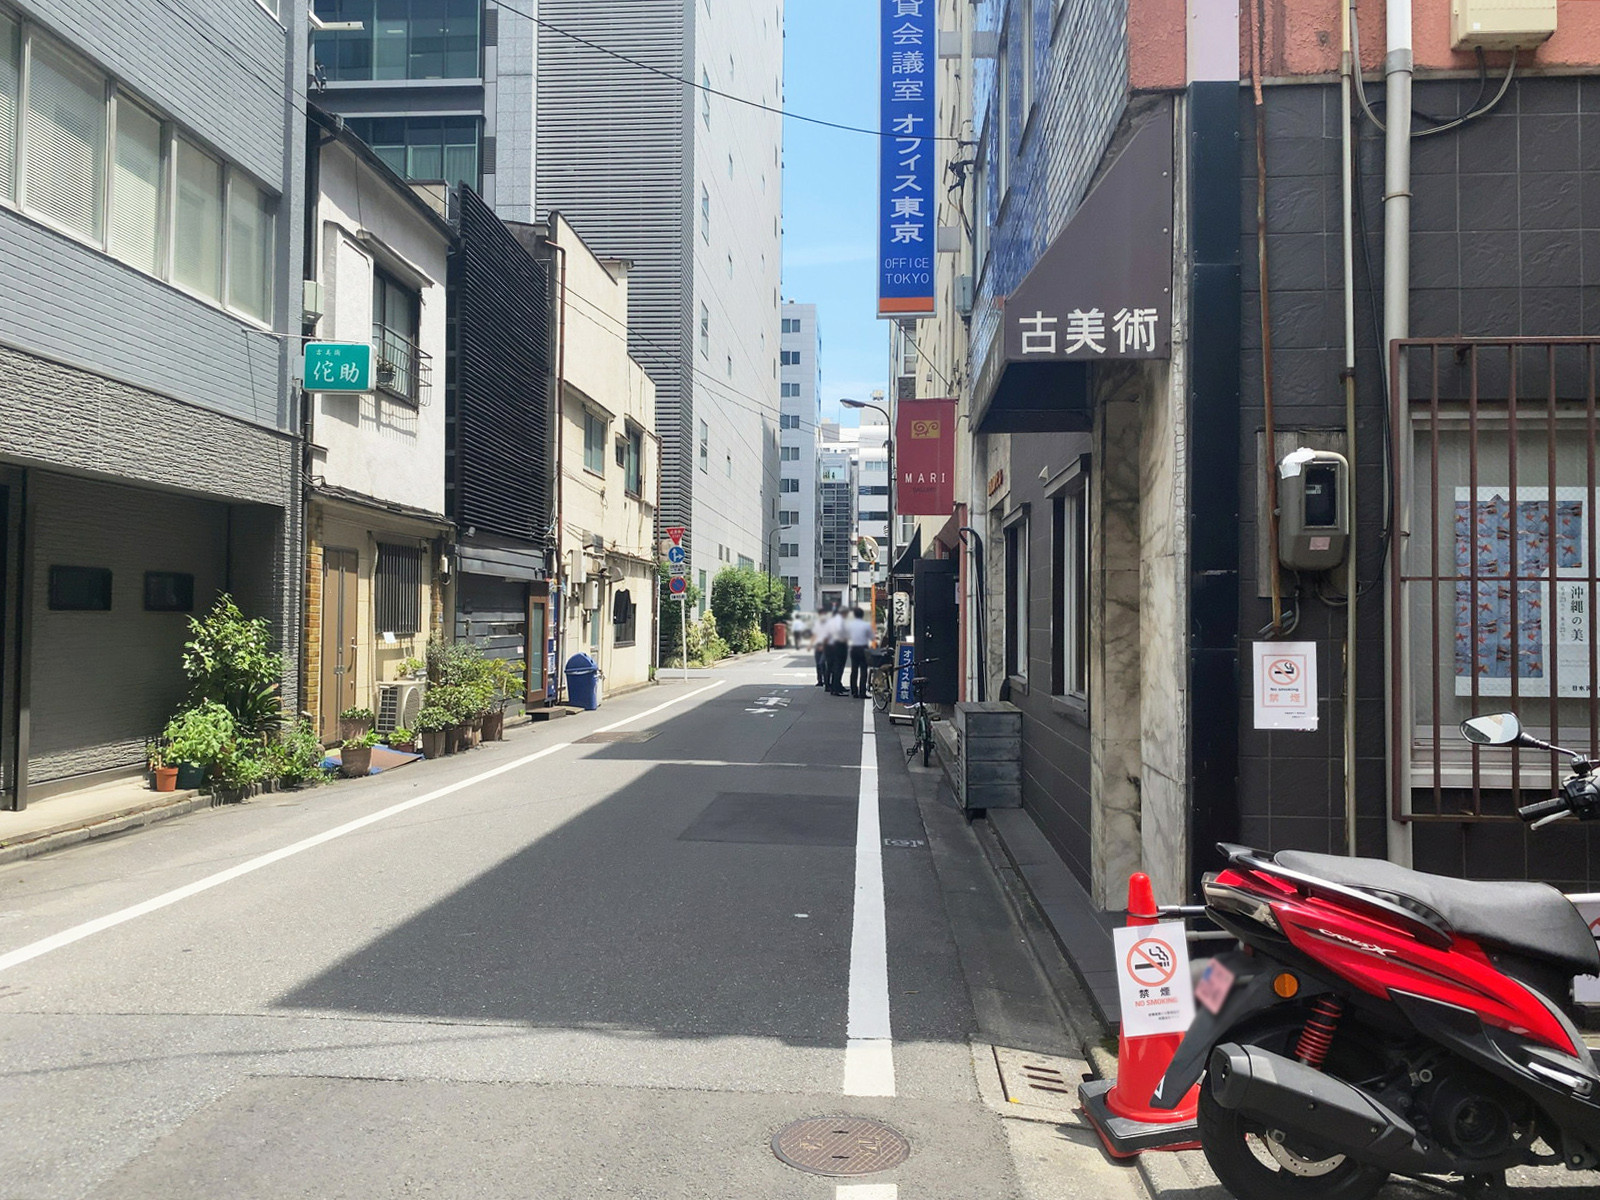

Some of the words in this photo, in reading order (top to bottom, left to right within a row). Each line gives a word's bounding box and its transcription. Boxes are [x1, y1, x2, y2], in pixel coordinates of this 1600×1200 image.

[890, 113, 925, 244] オフィス東京
[884, 257, 930, 269] OFFICE
[884, 272, 930, 285] TOKYO
[1018, 306, 1159, 355] 古美術
[904, 472, 946, 485] MARI
[895, 598, 905, 623] うどん
[1139, 986, 1171, 999] 禁煙
[1134, 1000, 1146, 1008] NO
